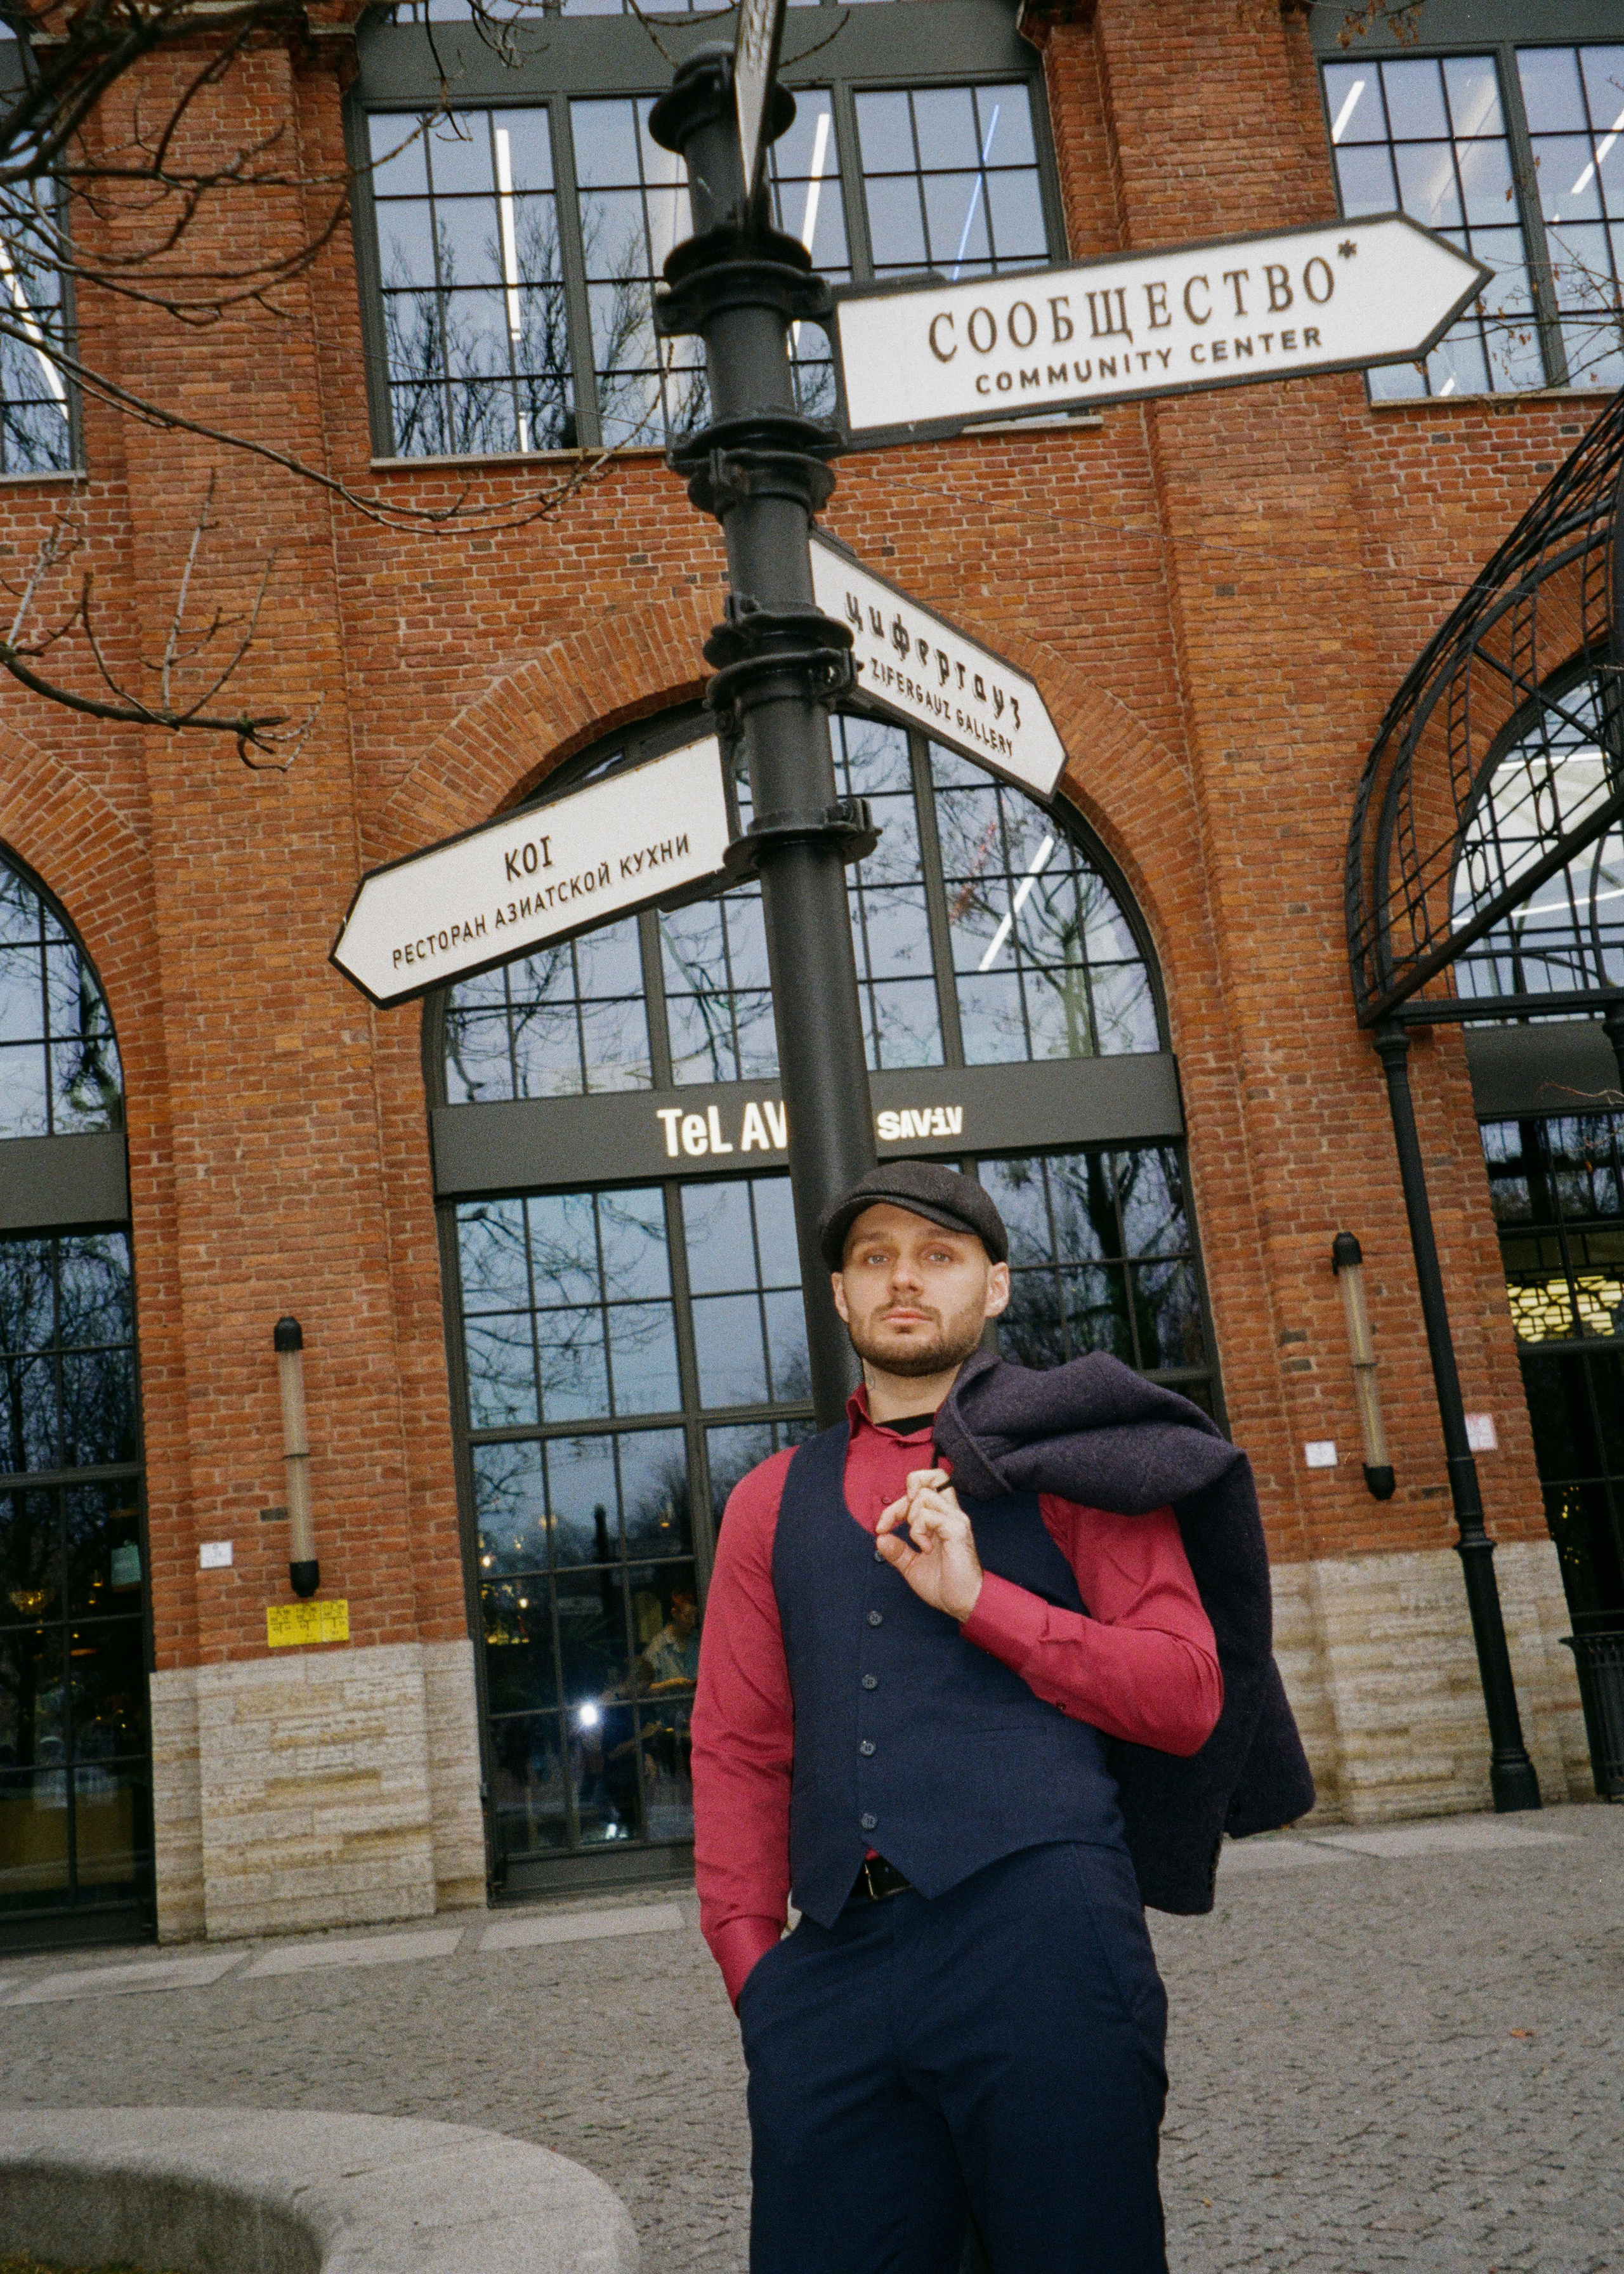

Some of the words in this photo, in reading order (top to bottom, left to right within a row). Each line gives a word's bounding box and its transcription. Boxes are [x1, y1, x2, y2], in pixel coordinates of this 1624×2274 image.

[976, 348, 1171, 395] COMMUNITY
[1191, 327, 1321, 363] CENTER
[870, 657, 951, 720] ZIFERGAUZ
[956, 709, 1012, 756] GALLERY
[392, 915, 487, 968] РЕСТОРАН
[495, 862, 611, 928] АЗИАТСКОЙ
[620, 834, 690, 877] КУХНИ
[741, 1100, 787, 1152] AV
